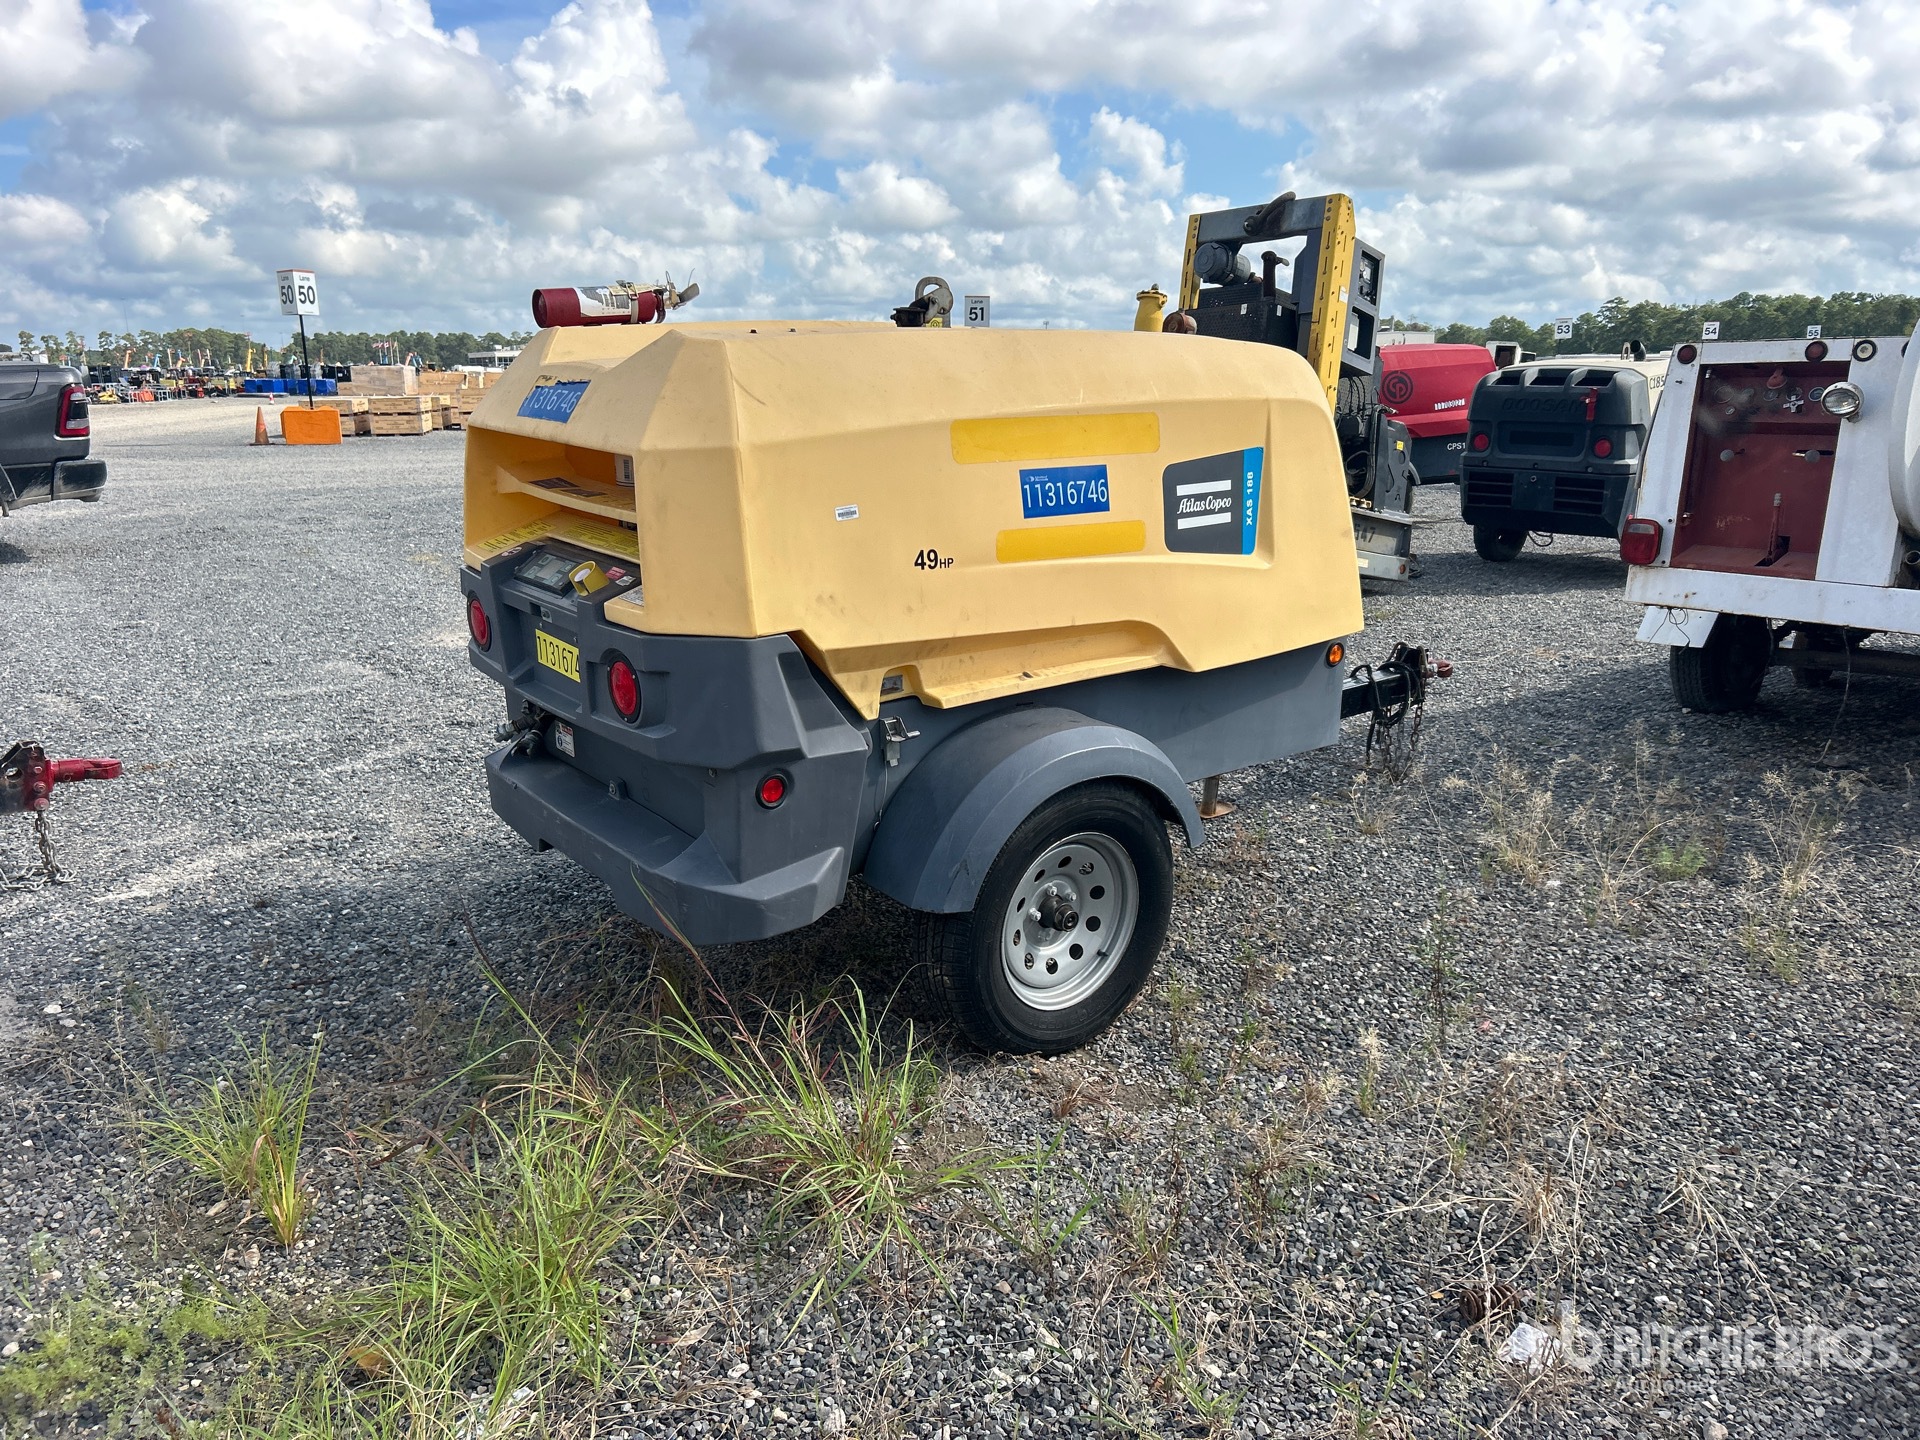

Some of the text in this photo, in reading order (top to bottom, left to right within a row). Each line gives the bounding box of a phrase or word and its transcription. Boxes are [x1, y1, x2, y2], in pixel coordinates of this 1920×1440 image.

[280, 285, 295, 305] 50
[298, 285, 316, 305] 50
[969, 306, 985, 322] 51
[1556, 324, 1571, 335] 53
[1704, 327, 1717, 336] 54
[1808, 329, 1820, 337] 55
[1447, 442, 1467, 451] CPS1
[1023, 478, 1109, 509] 11316746
[1246, 499, 1254, 526] XAS
